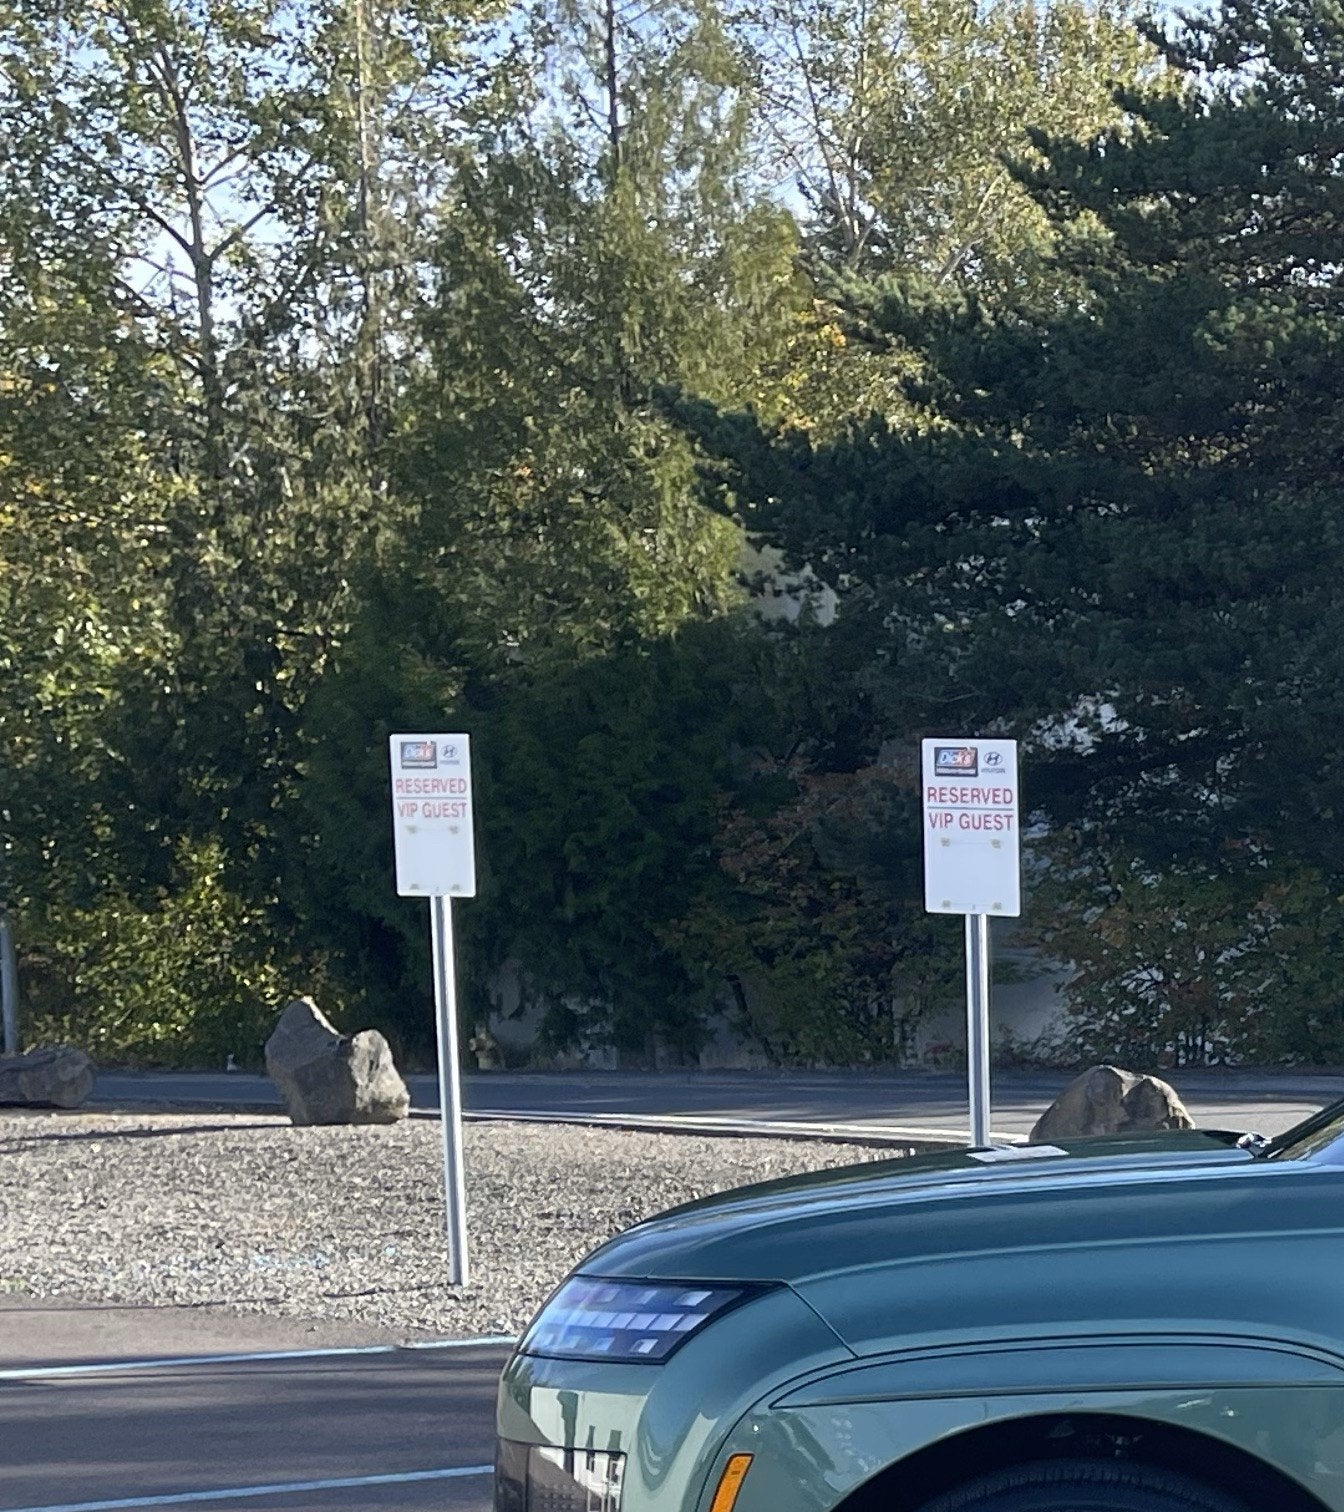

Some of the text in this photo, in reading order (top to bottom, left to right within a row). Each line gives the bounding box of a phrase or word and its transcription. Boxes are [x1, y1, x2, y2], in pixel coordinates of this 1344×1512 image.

[395, 777, 467, 794] RESERVED
[926, 786, 1014, 805] RESERVED
[397, 802, 467, 819] VIP GUEST
[928, 812, 1015, 832] VIP GUEST
